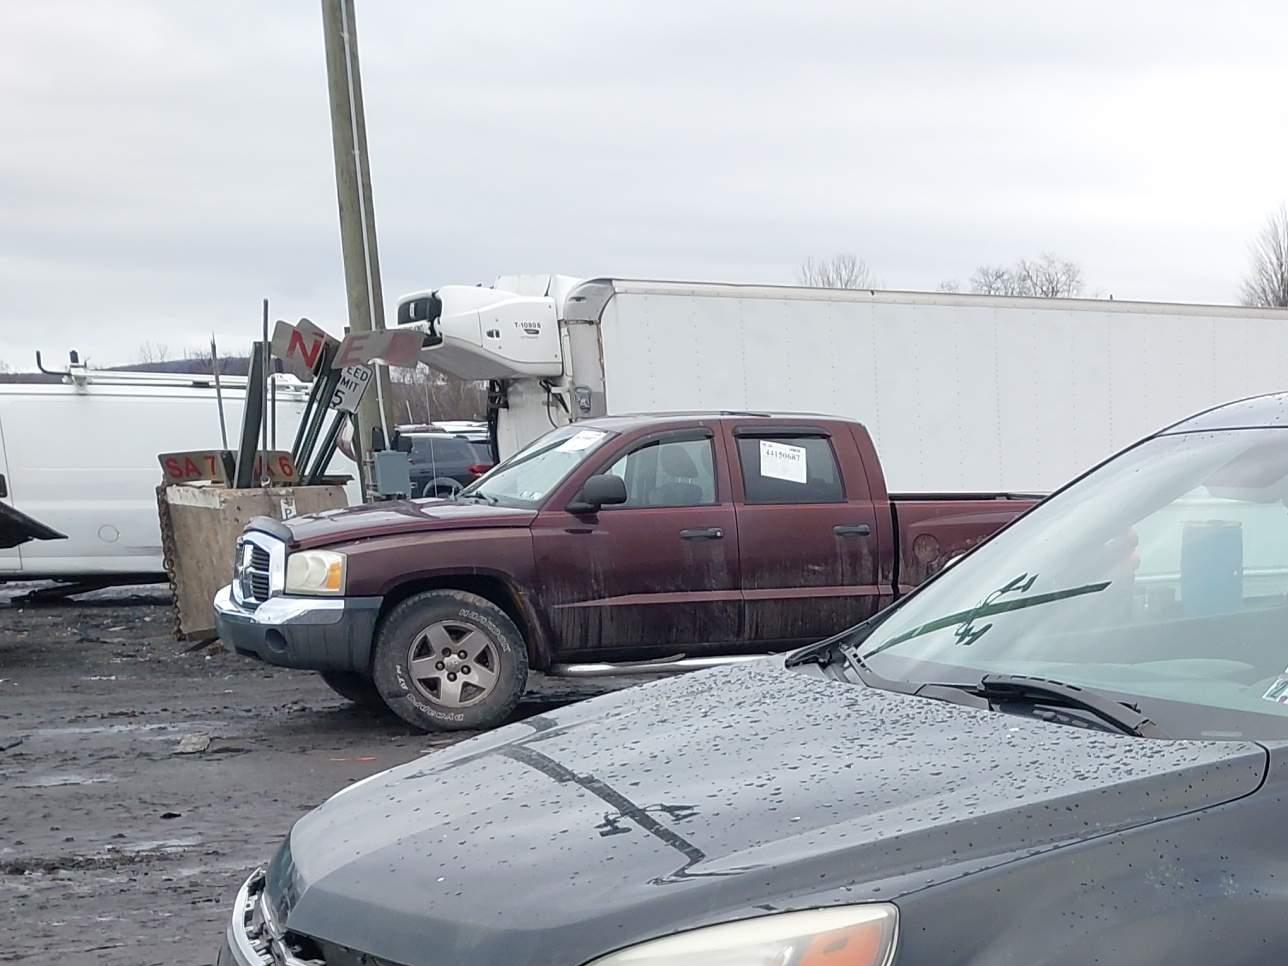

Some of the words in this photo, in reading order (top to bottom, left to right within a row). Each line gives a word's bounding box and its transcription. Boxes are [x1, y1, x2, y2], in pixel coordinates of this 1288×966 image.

[340, 377, 359, 392] MIT
[165, 456, 202, 478] SA
[203, 455, 217, 476] 7
[278, 456, 294, 477] 6
